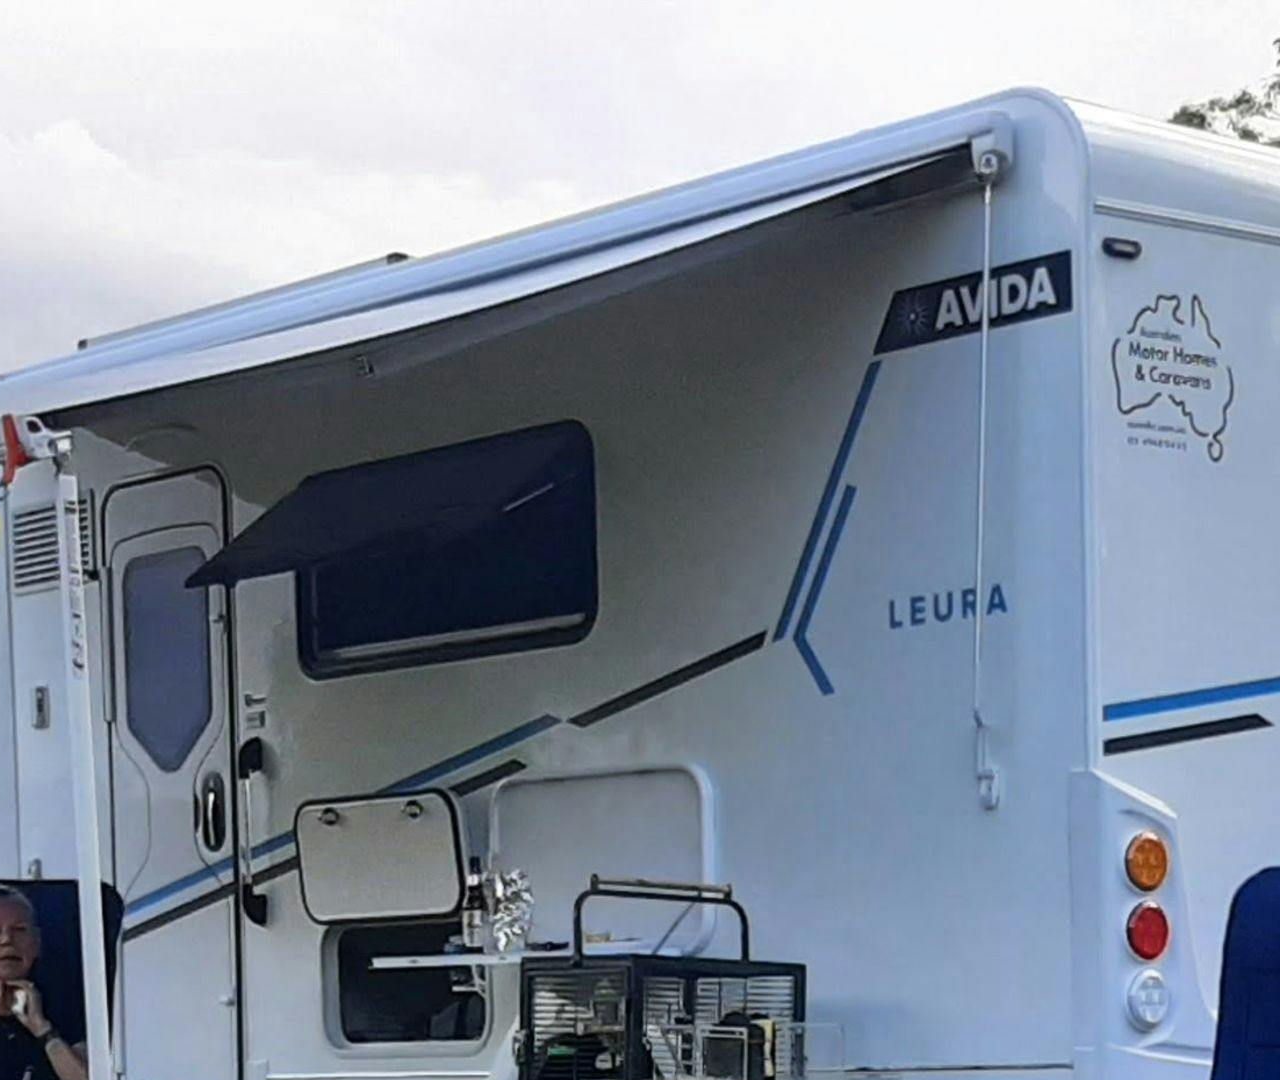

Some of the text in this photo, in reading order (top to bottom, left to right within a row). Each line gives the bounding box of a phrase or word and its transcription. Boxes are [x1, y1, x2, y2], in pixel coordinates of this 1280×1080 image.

[935, 267, 1057, 331] AVIDA
[1128, 340, 1218, 368] Motor Homes
[1135, 364, 1145, 383] &
[888, 583, 1008, 630] LEURA
